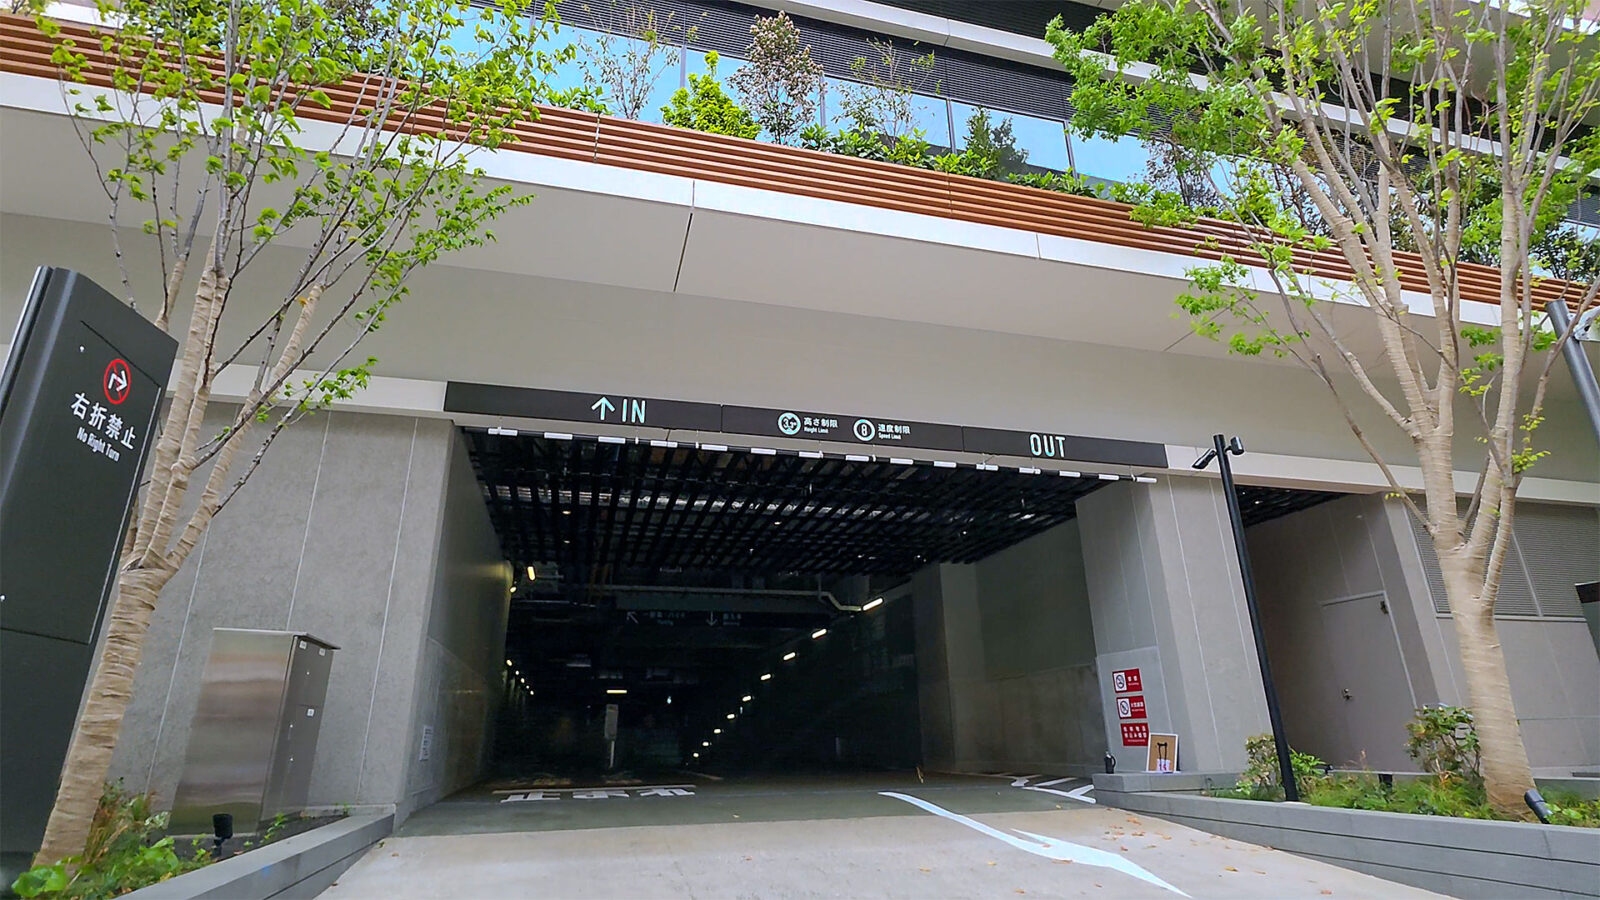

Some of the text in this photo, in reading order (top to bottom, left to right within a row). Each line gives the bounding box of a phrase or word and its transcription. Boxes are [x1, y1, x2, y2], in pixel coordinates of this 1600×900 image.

[70, 392, 137, 450] 右折禁止
[621, 398, 646, 424] IN
[804, 416, 838, 428] 高さ制限
[861, 424, 868, 436] 8
[877, 423, 911, 435] 速度制限
[76, 426, 121, 462] No Right Turn
[1029, 433, 1066, 458] OUT
